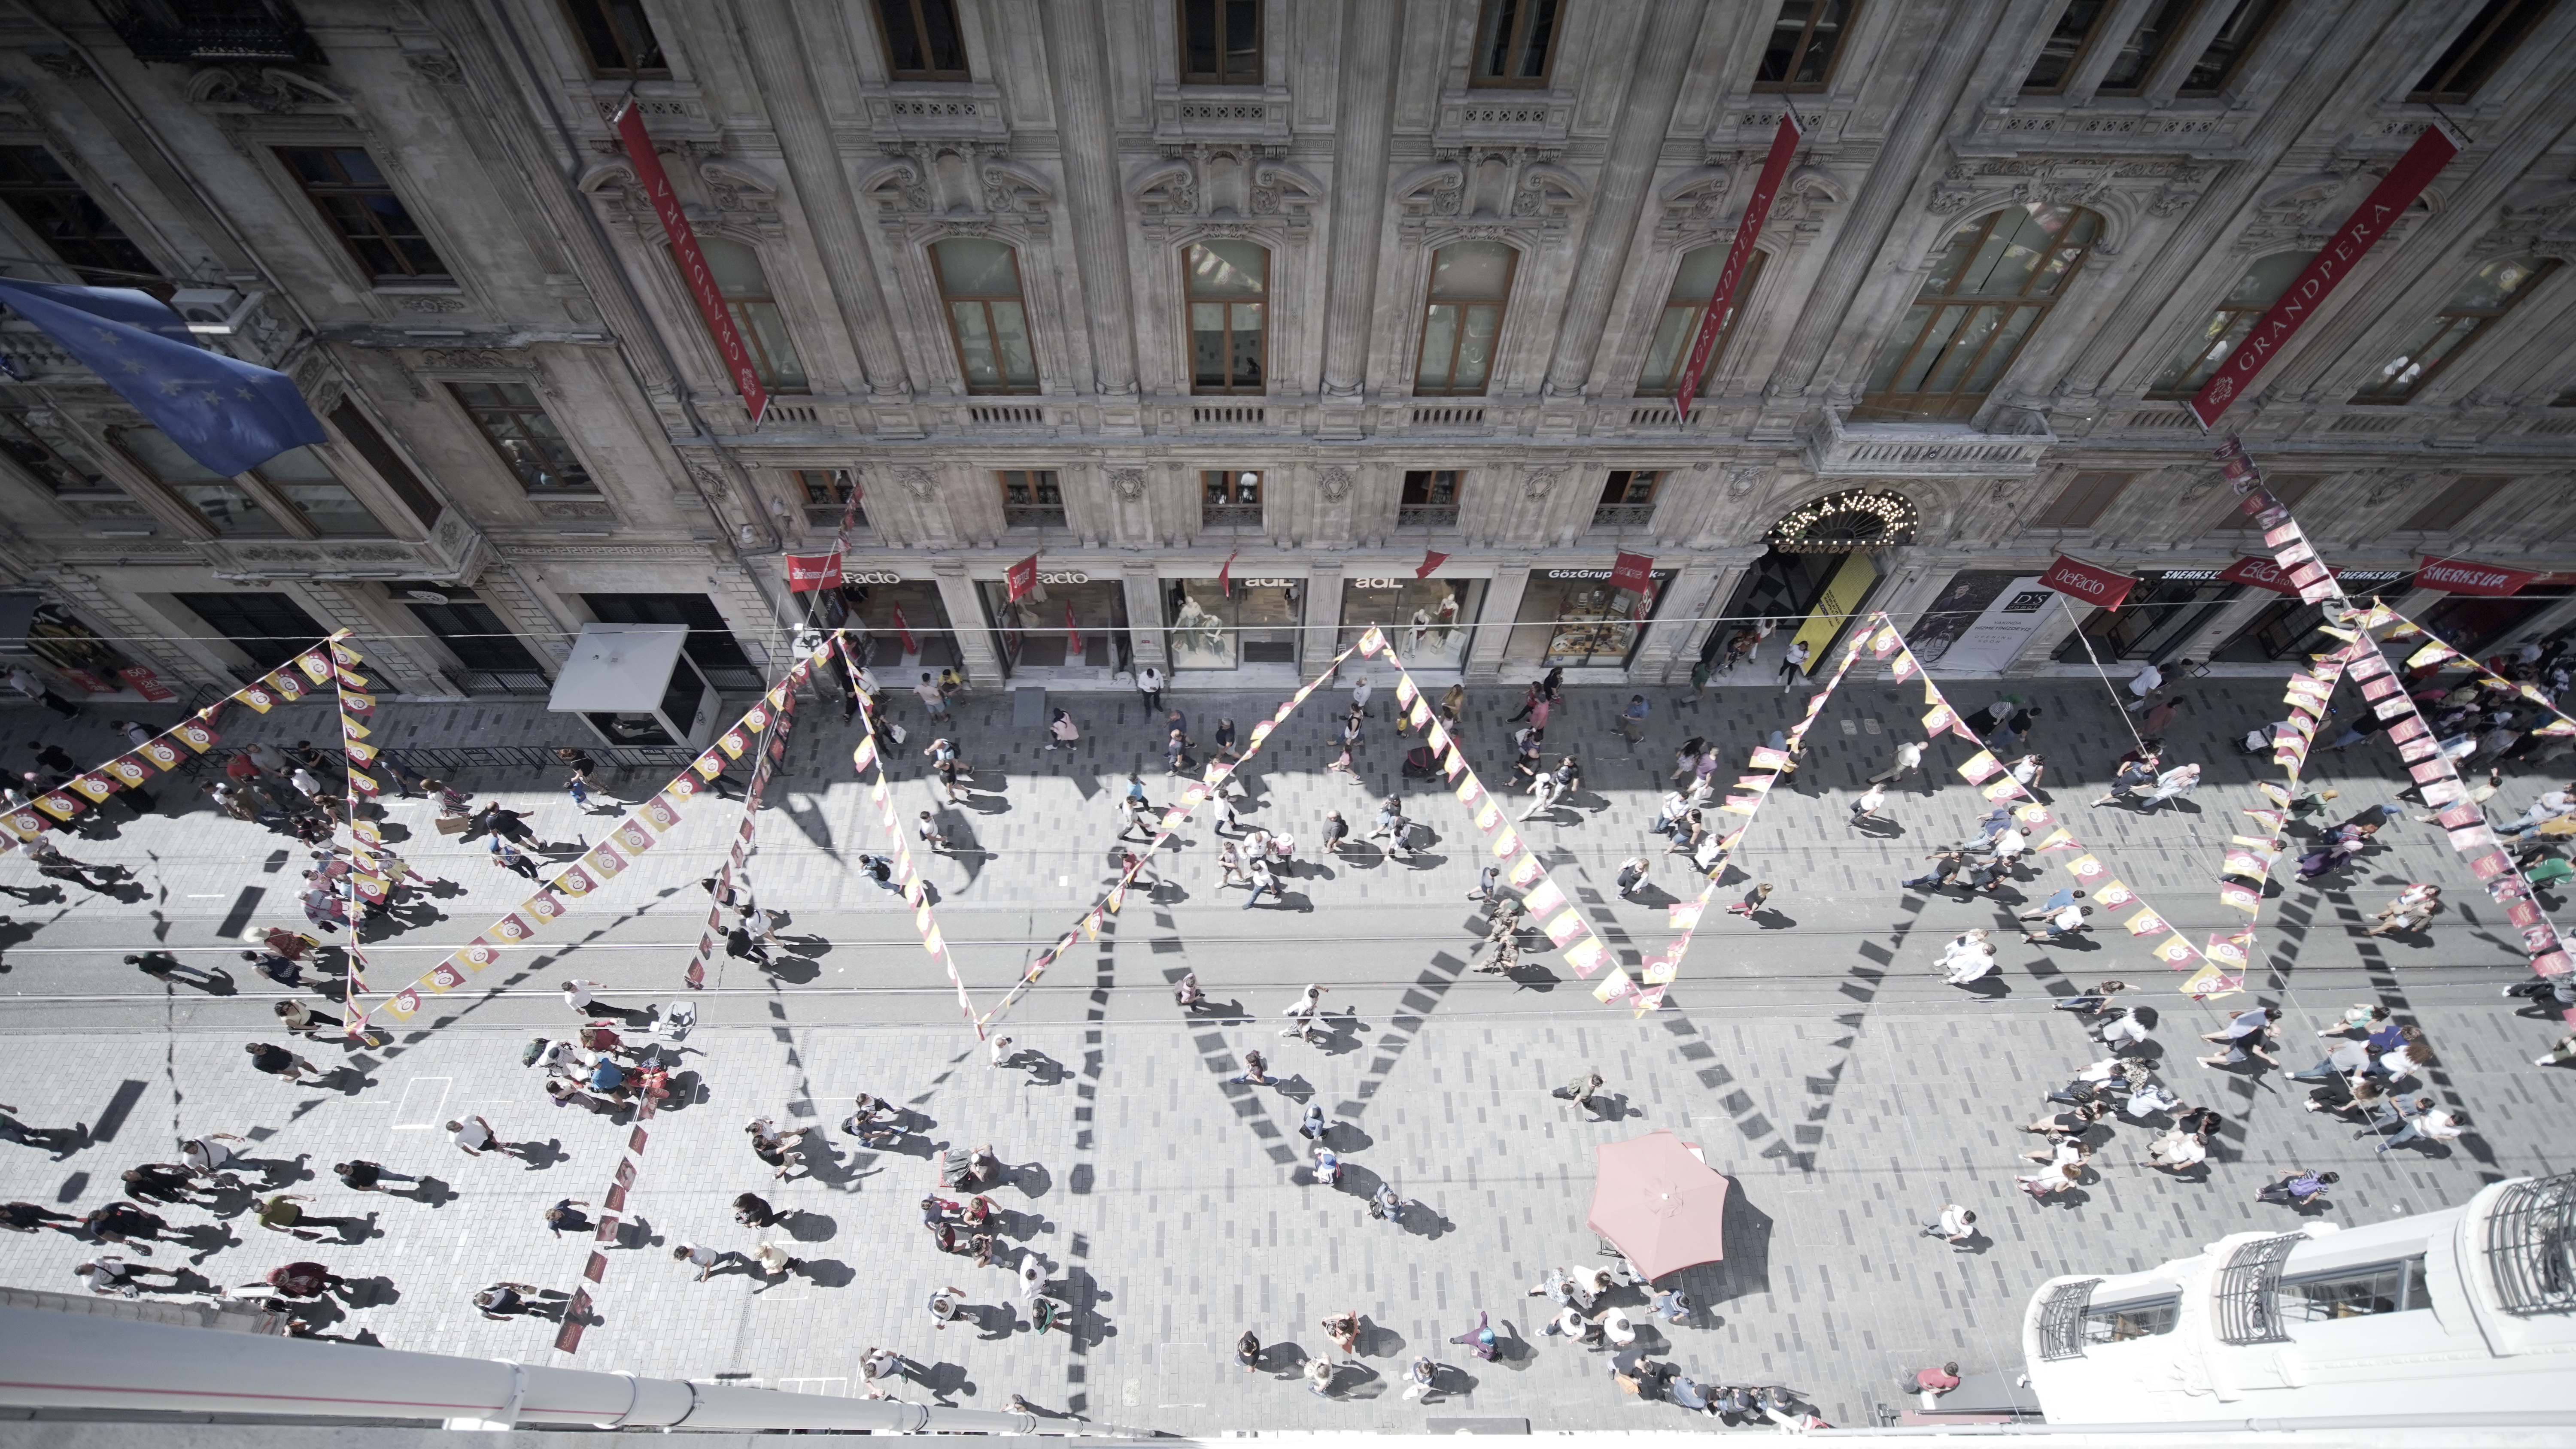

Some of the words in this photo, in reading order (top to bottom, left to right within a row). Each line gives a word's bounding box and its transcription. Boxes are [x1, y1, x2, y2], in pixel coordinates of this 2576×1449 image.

[1696, 193, 1766, 364] GRANDPERA
[2239, 203, 2392, 372] GRANDPERA
[1777, 545, 1884, 554] GRANDPERA
[1548, 570, 1613, 579] GözGrup
[2239, 561, 2280, 582] B&G
[2055, 568, 2105, 594] DeFacto
[127, 668, 146, 677] 50
[141, 679, 160, 688] 20
